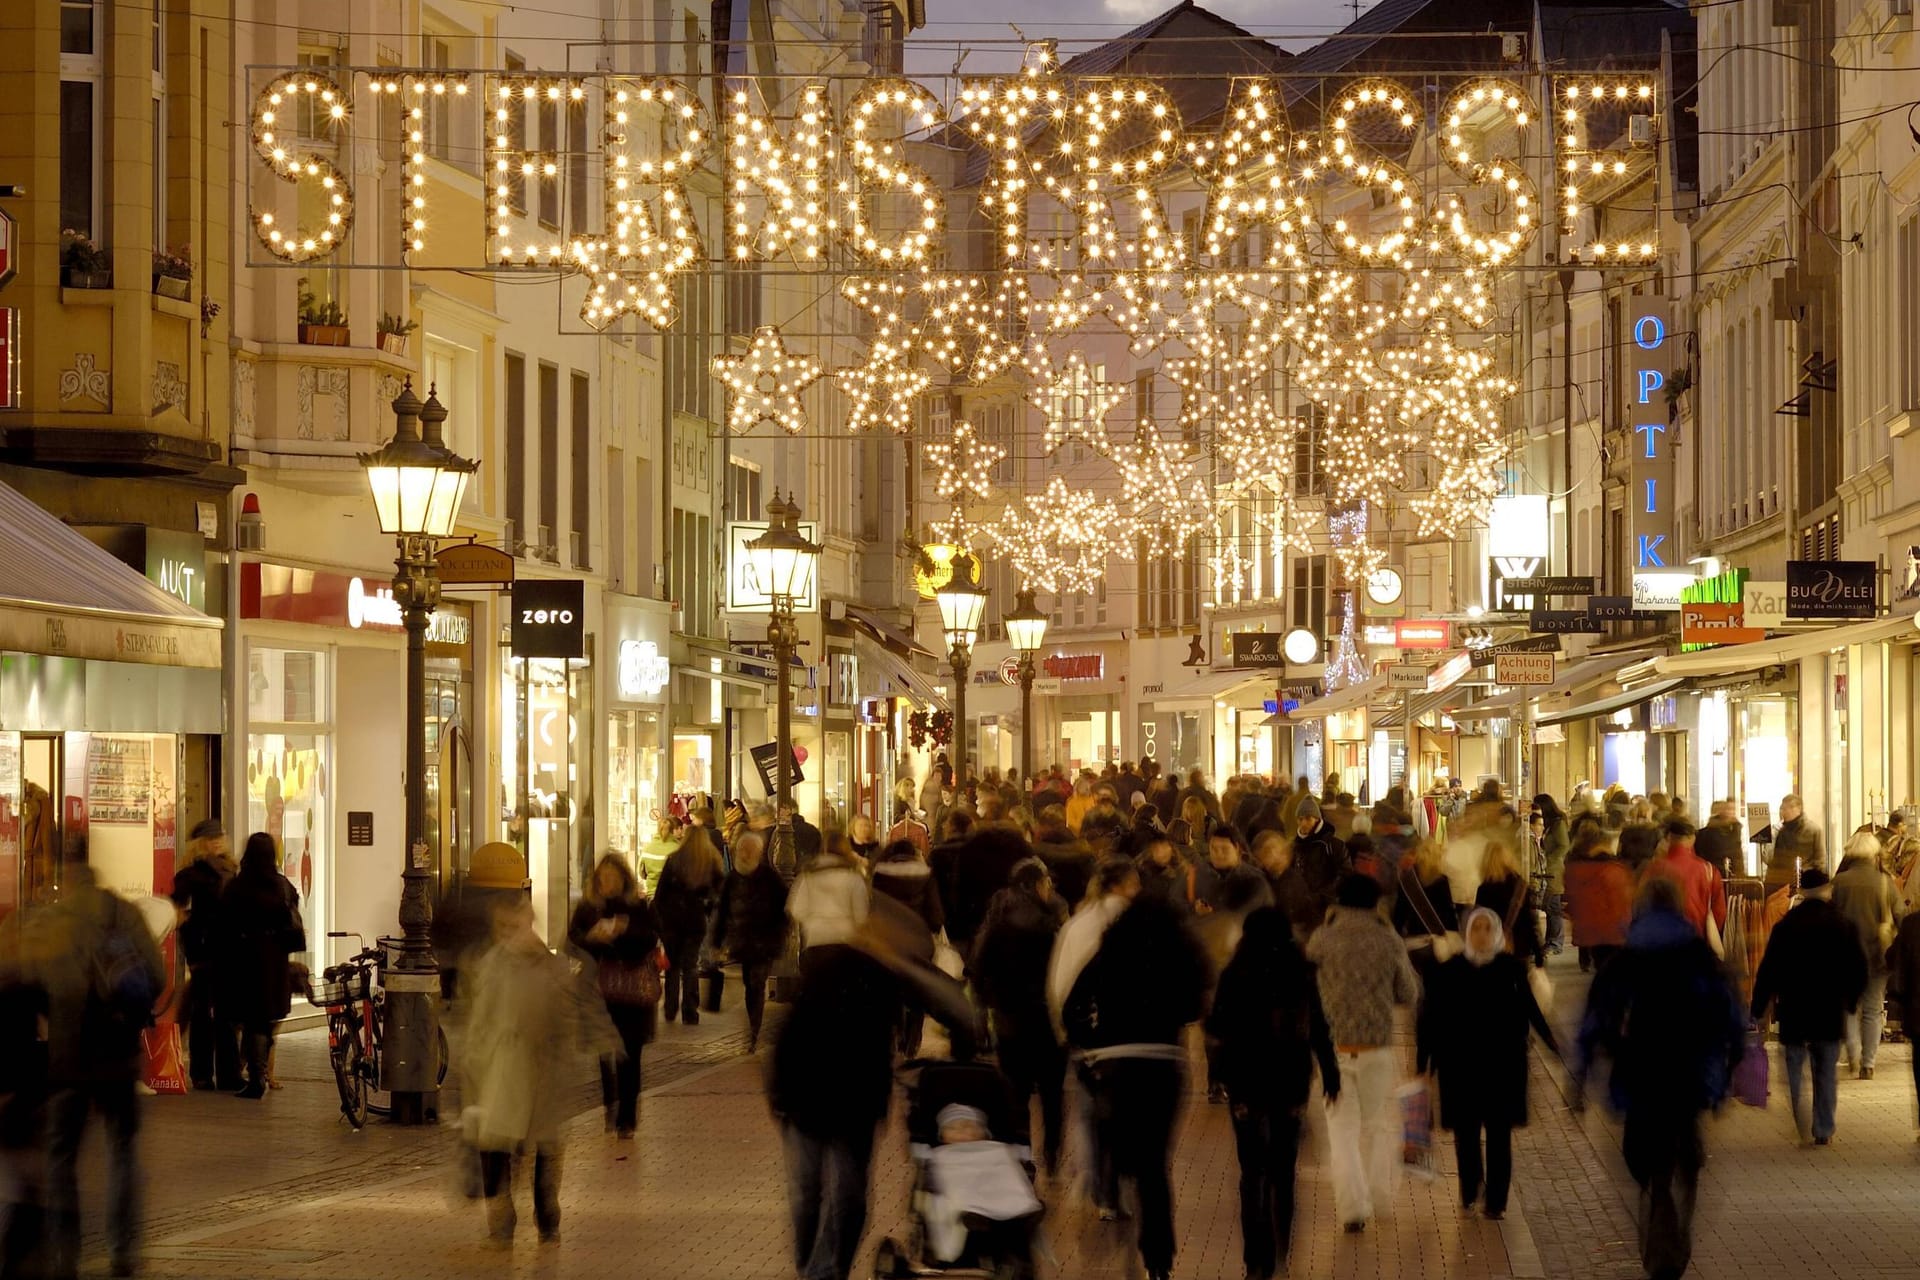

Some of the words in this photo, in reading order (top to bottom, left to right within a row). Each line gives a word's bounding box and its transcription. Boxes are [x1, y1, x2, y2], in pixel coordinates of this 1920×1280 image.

[1634, 315, 1665, 567] OPTIK
[1507, 578, 1546, 588] STERN
[522, 609, 574, 624] zero
[1538, 615, 1594, 631] BONITA
[1240, 654, 1279, 662] SWAROVSKI
[1500, 656, 1551, 670] Achtung
[1500, 671, 1550, 682] Markise
[1143, 682, 1163, 696] promod
[150, 1077, 180, 1089] Xanaka
